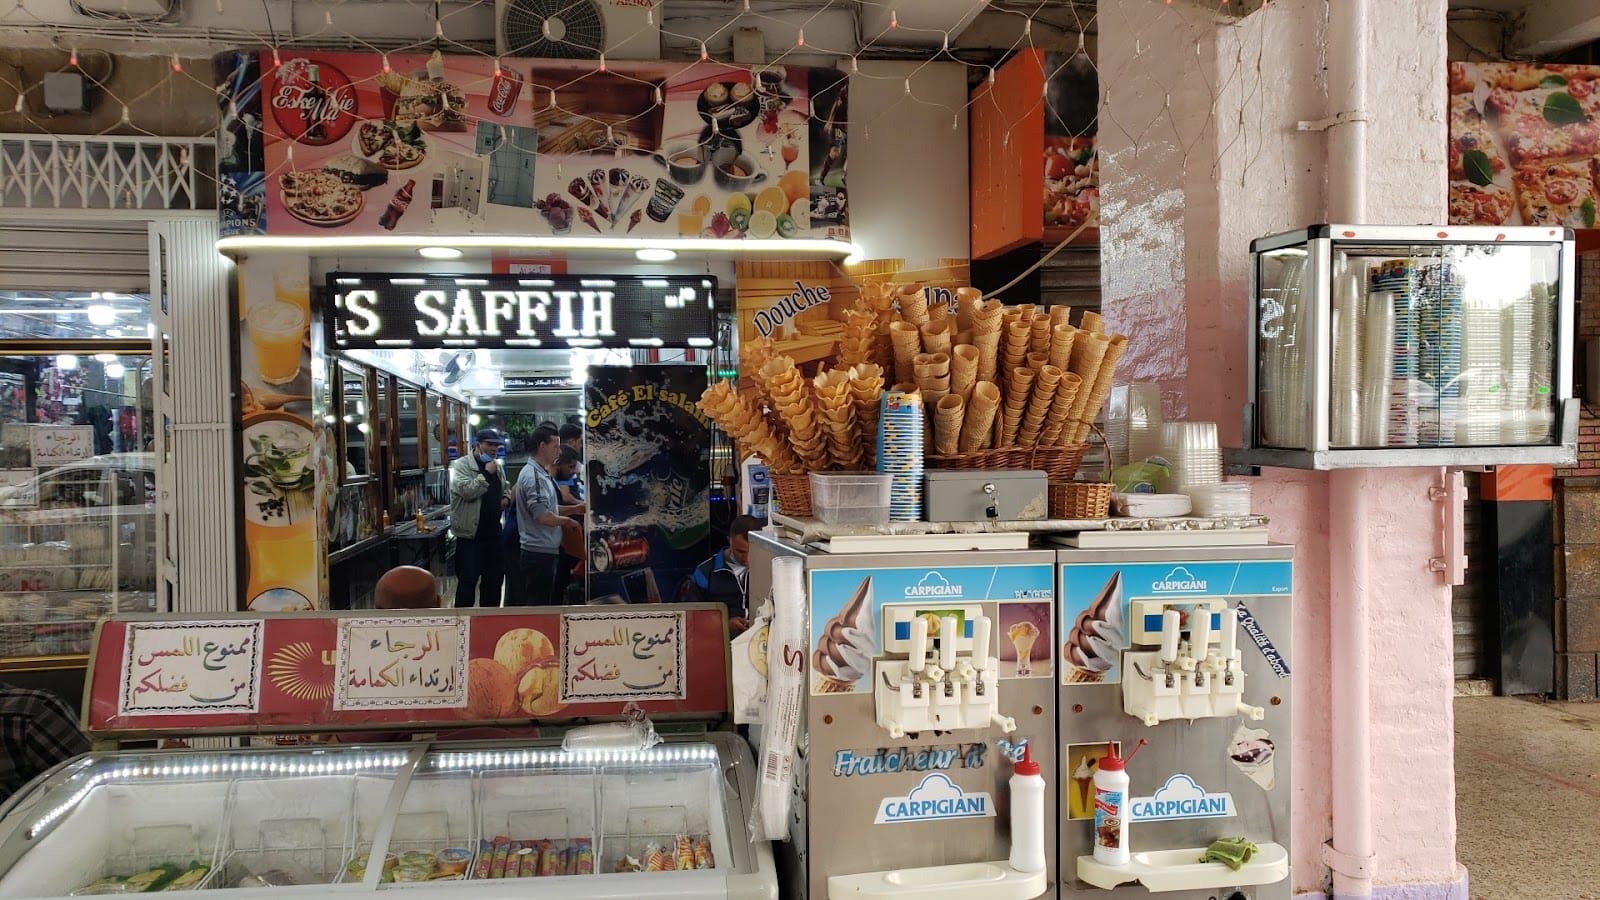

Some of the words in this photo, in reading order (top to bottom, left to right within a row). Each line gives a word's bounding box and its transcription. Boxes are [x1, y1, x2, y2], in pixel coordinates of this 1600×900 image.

[414, 289, 617, 337] SAFFIH
[753, 279, 831, 338] Douche
[587, 389, 628, 428] Café
[632, 384, 654, 401] El
[904, 585, 962, 596] CARPIGIANI
[1152, 580, 1207, 591] CARPIGIANI
[137, 635, 200, 666] اللمس
[202, 636, 250, 670] ممنوع
[573, 627, 630, 656] اللمس
[632, 628, 674, 660] ممنوع
[133, 668, 188, 704] فضلكم
[349, 658, 405, 688] الكمامة
[571, 657, 622, 693] فضلكم
[621, 664, 674, 690] من
[189, 678, 246, 703] من
[884, 797, 985, 818] CARPIGIANI
[1131, 797, 1227, 817] CARPIGIANI
